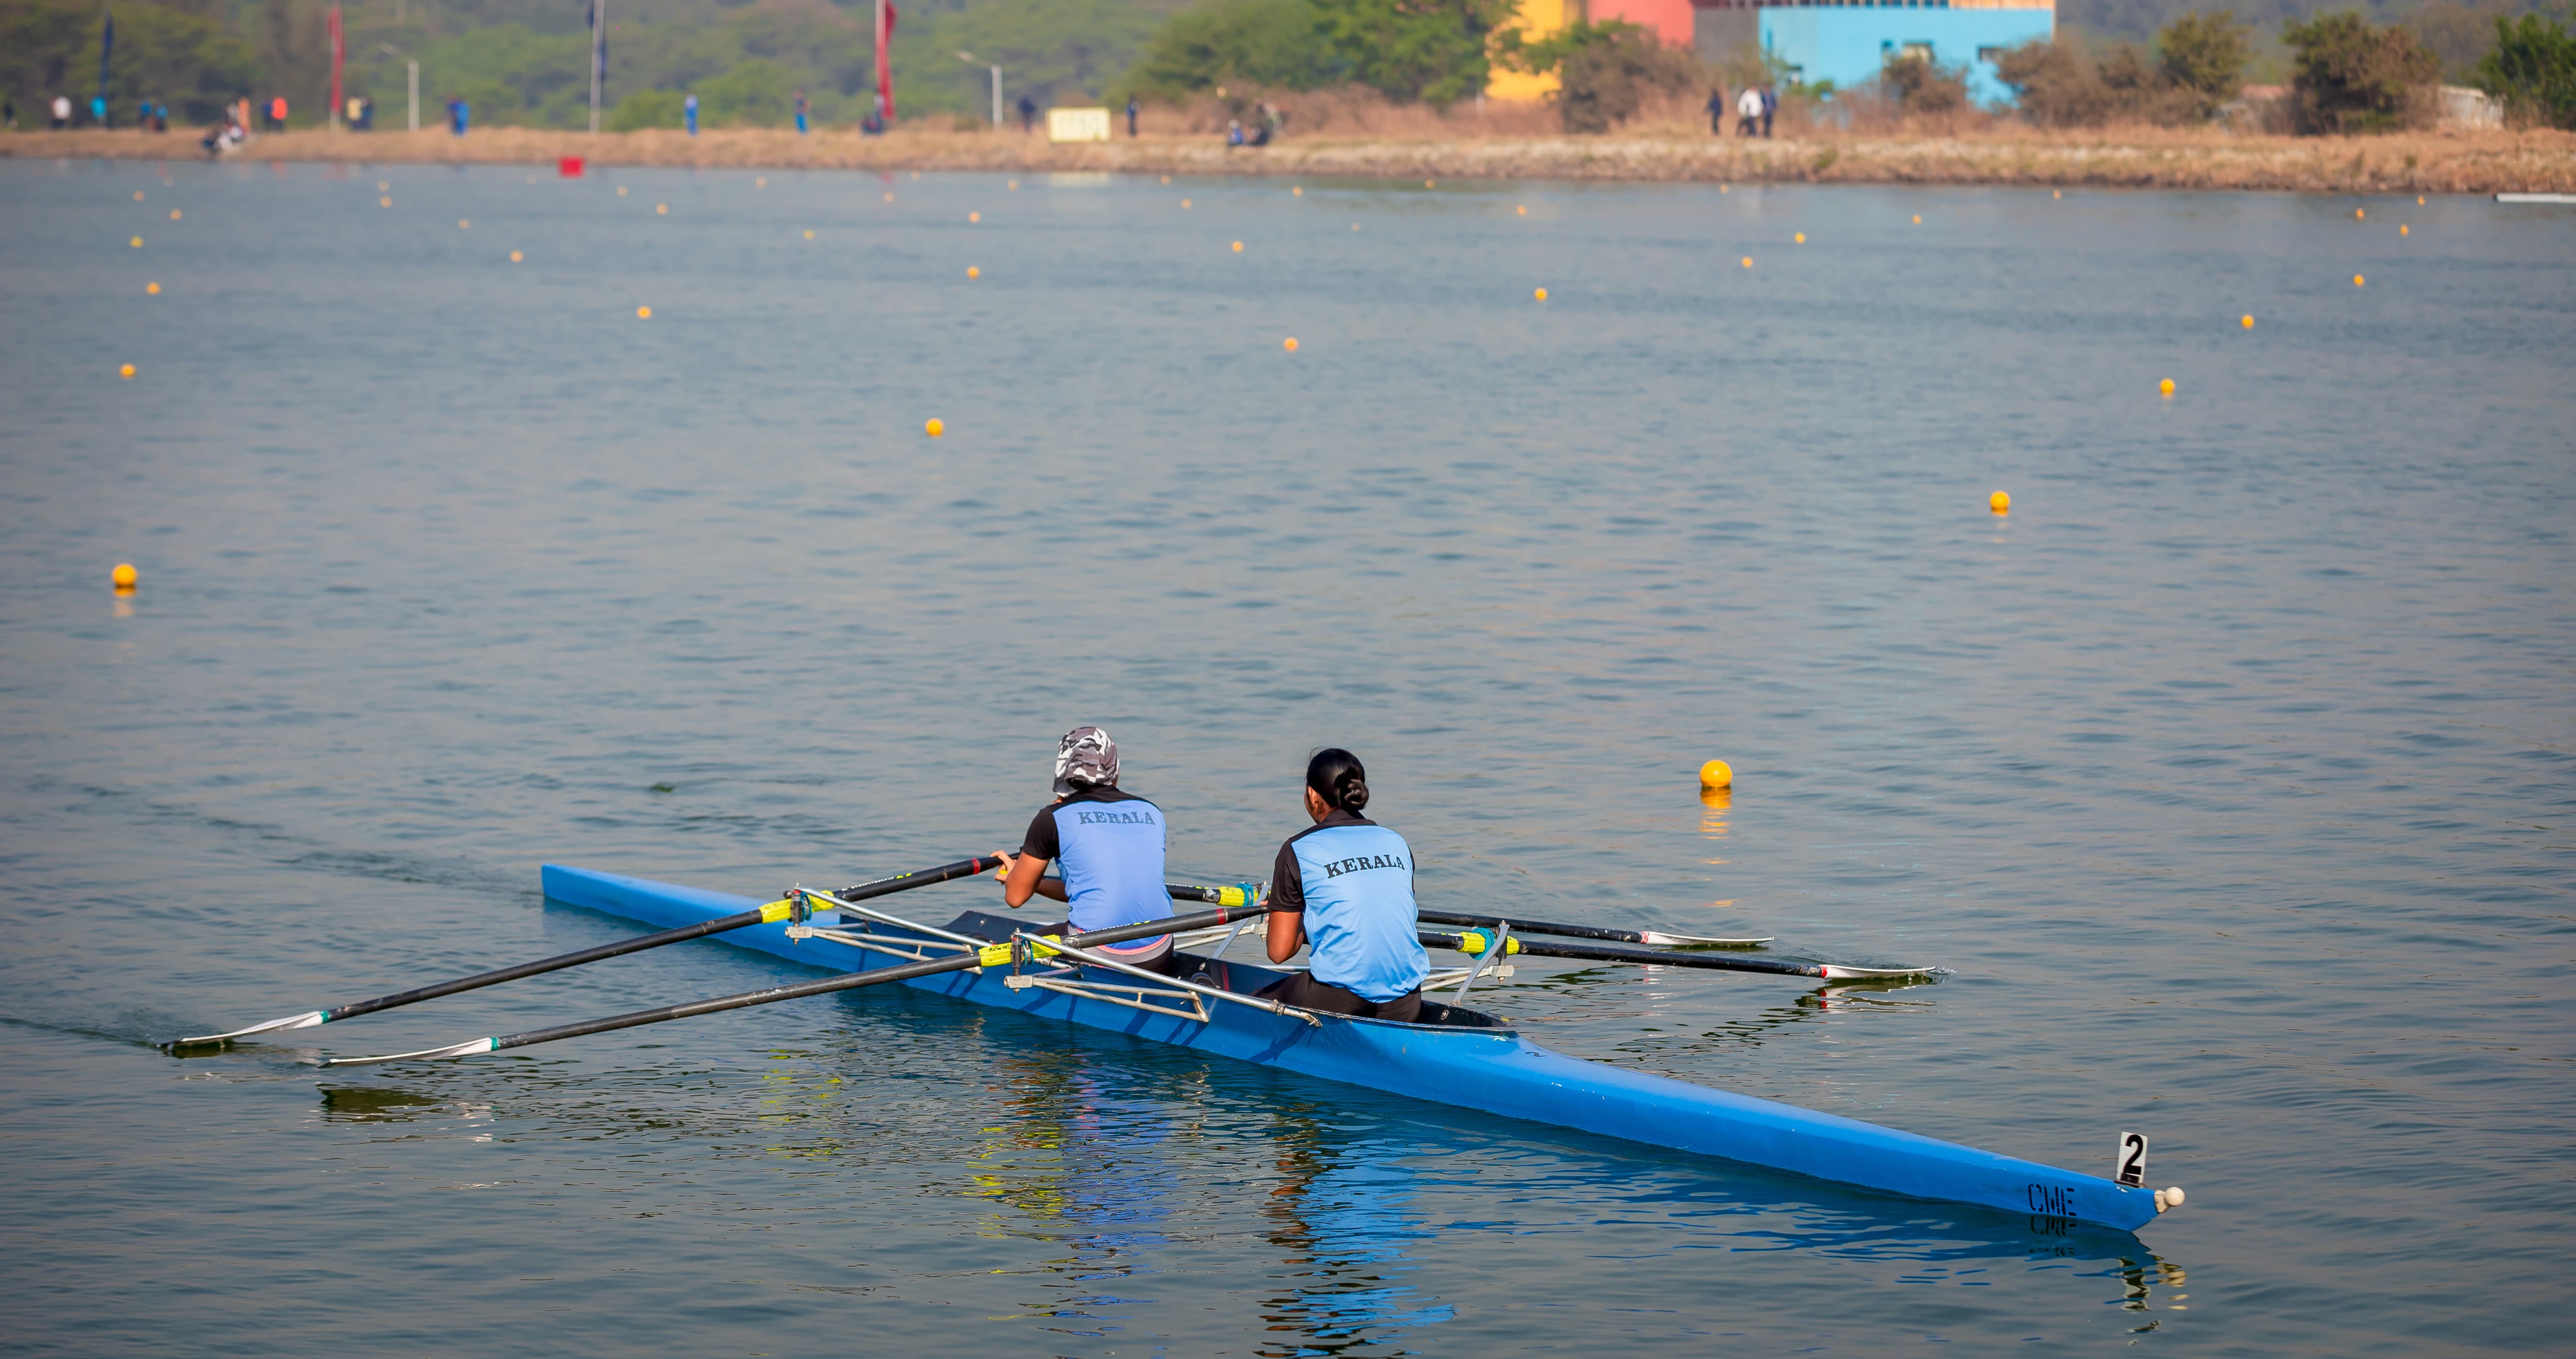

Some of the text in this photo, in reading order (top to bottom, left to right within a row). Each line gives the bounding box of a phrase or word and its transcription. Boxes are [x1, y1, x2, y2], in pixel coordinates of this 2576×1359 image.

[1078, 811, 1156, 825] KERALA
[1323, 855, 1405, 878] KERALA
[2123, 1134, 2143, 1175] 2
[2028, 1183, 2076, 1216] CME
